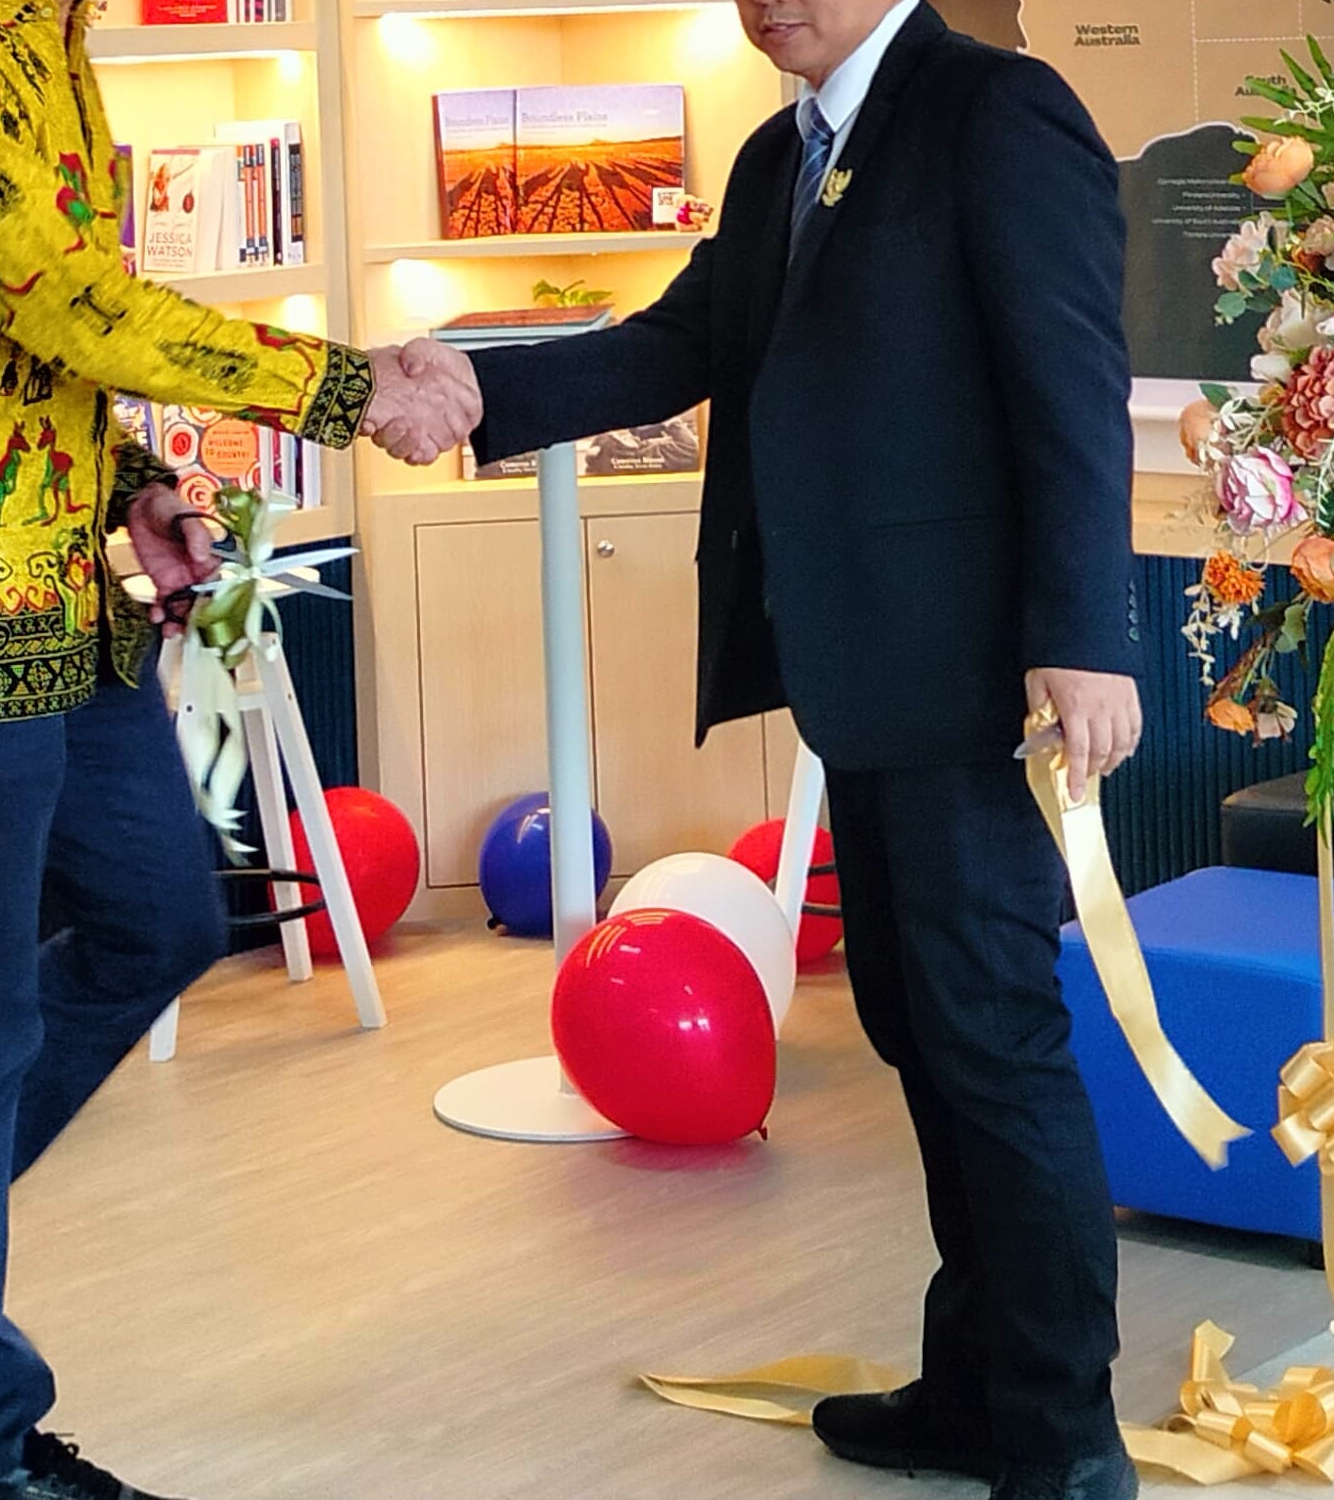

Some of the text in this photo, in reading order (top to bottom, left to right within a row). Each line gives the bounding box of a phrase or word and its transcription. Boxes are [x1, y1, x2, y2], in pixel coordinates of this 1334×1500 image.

[1075, 24, 1139, 35] Western
[1074, 34, 1141, 47] Australia
[522, 112, 574, 123] Boundless
[149, 231, 192, 244] JESSICA
[147, 244, 192, 258] WATSON
